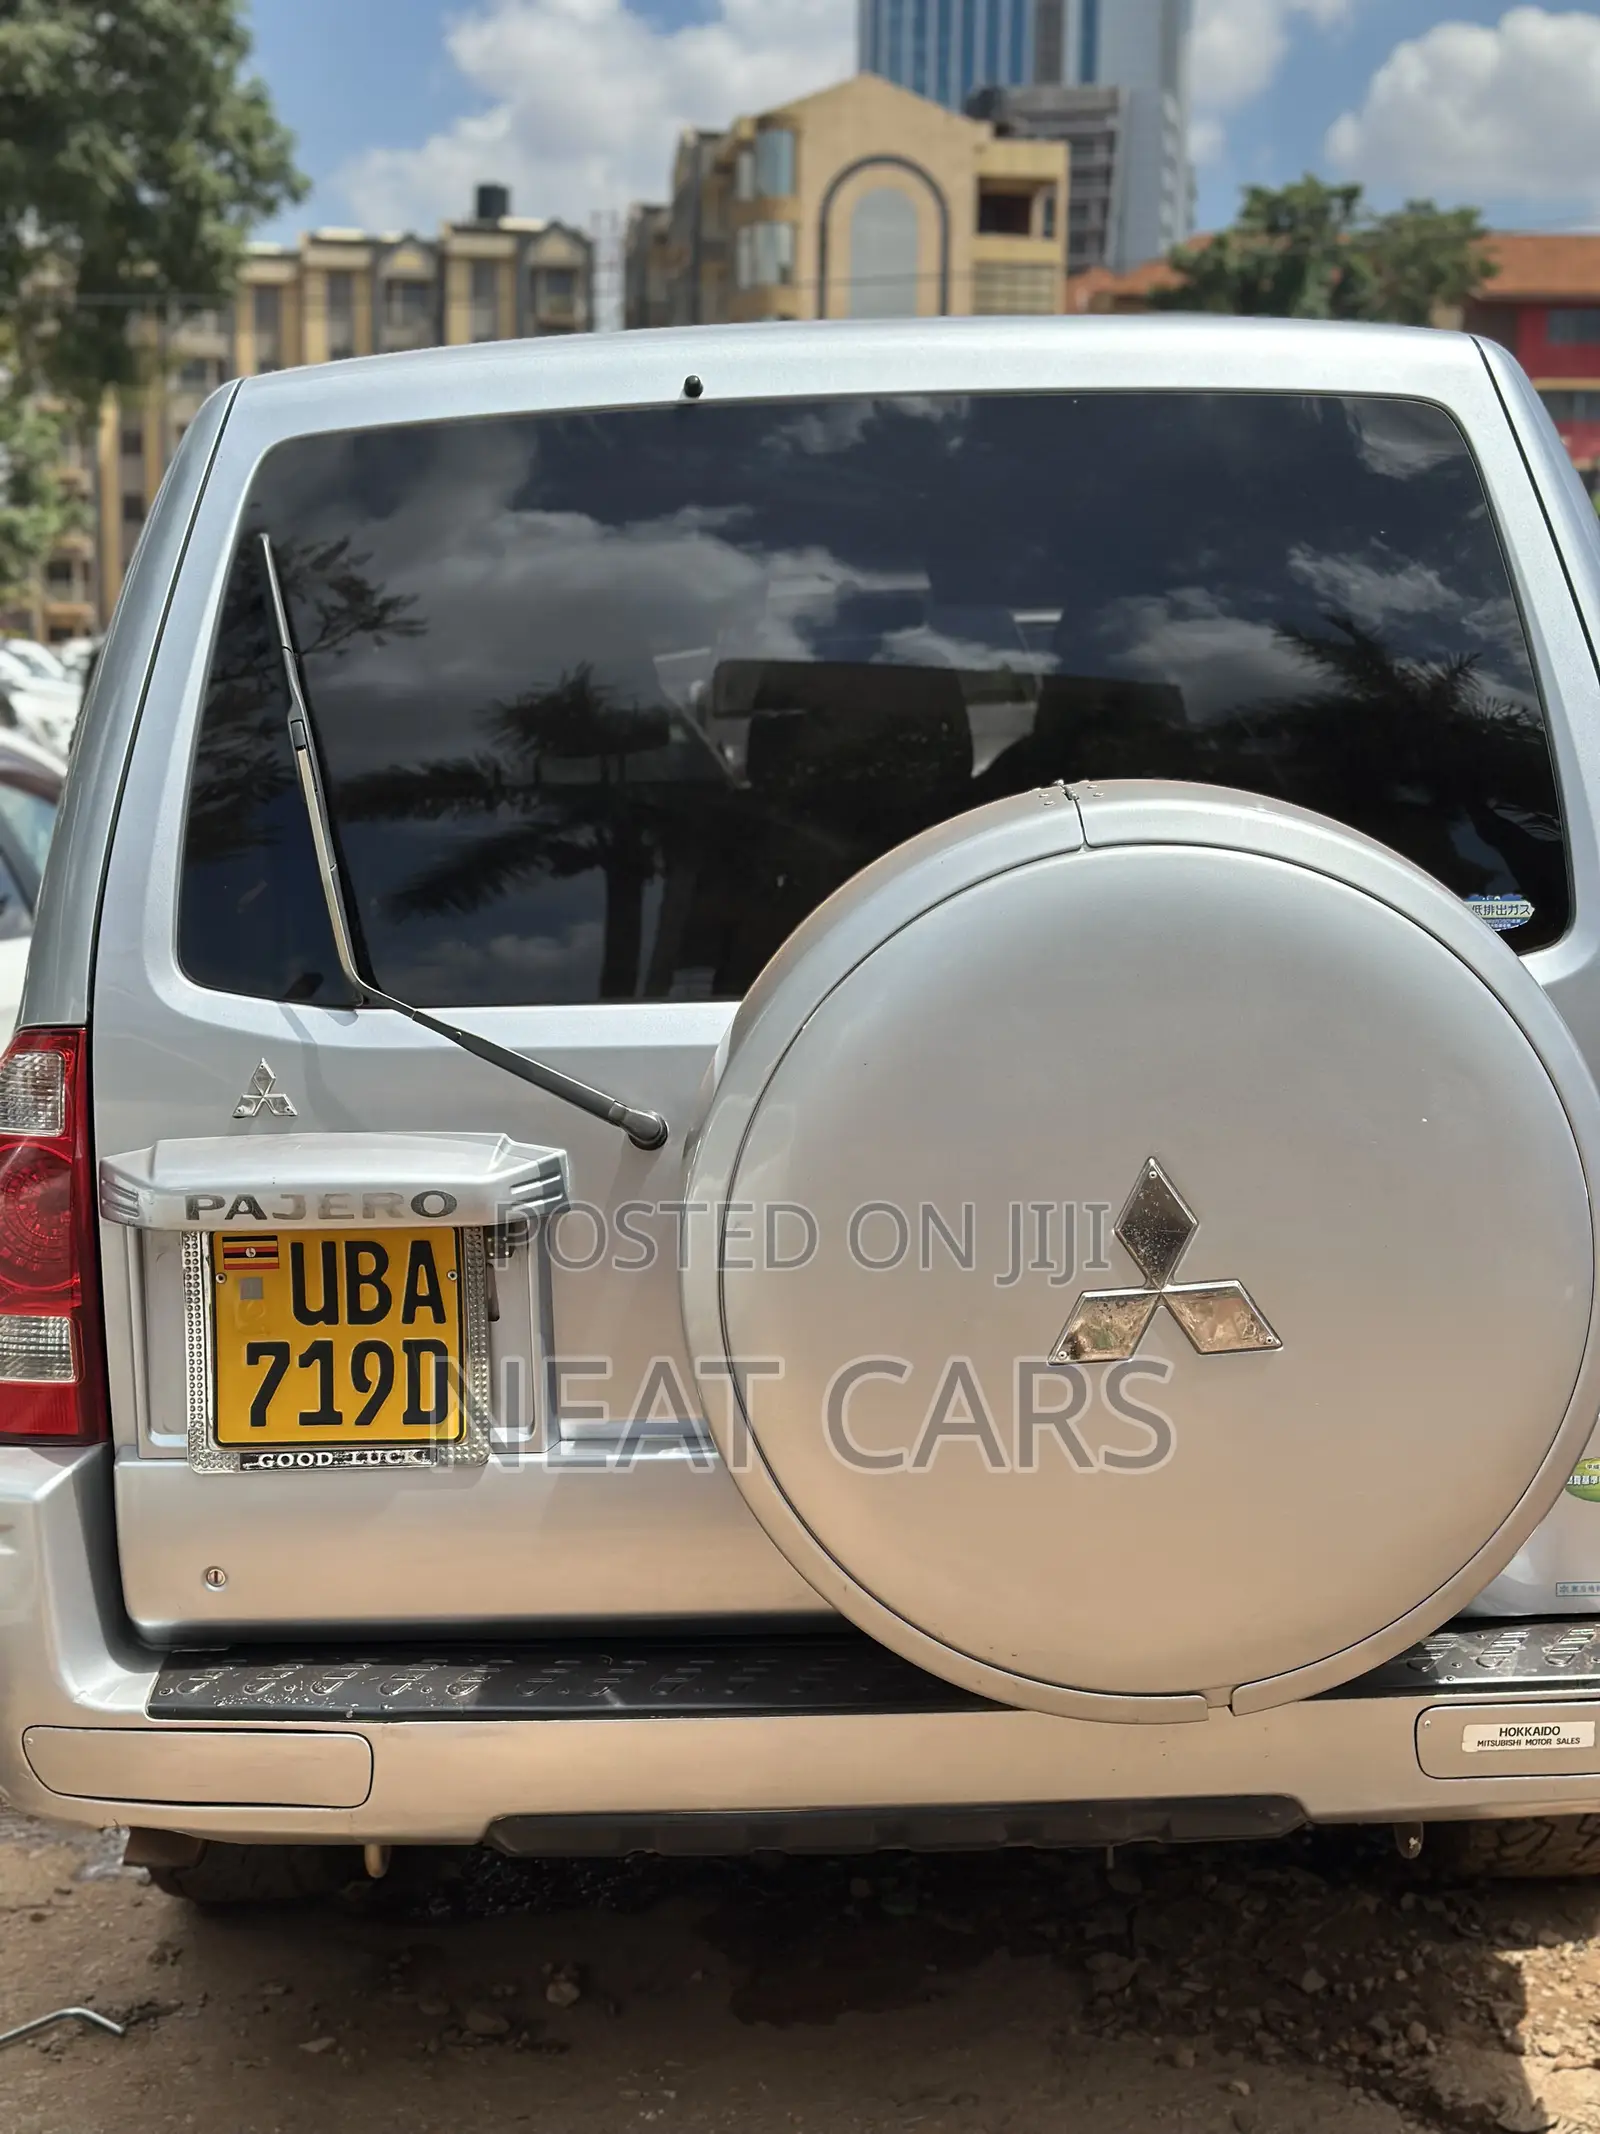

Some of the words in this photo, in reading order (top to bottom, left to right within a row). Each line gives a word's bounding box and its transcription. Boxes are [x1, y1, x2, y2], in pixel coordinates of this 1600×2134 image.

[184, 1189, 458, 1221] PAJERO
[290, 1239, 447, 1326] UBA
[245, 1338, 449, 1428] 719D
[257, 1451, 334, 1469] GOOD
[349, 1449, 423, 1465] LUCK
[1477, 1739, 1522, 1747] MITSUBISHI
[1525, 1738, 1553, 1746] MOTOR
[1556, 1737, 1581, 1745] SALES
[1499, 1725, 1561, 1737] HOKKAIDO
